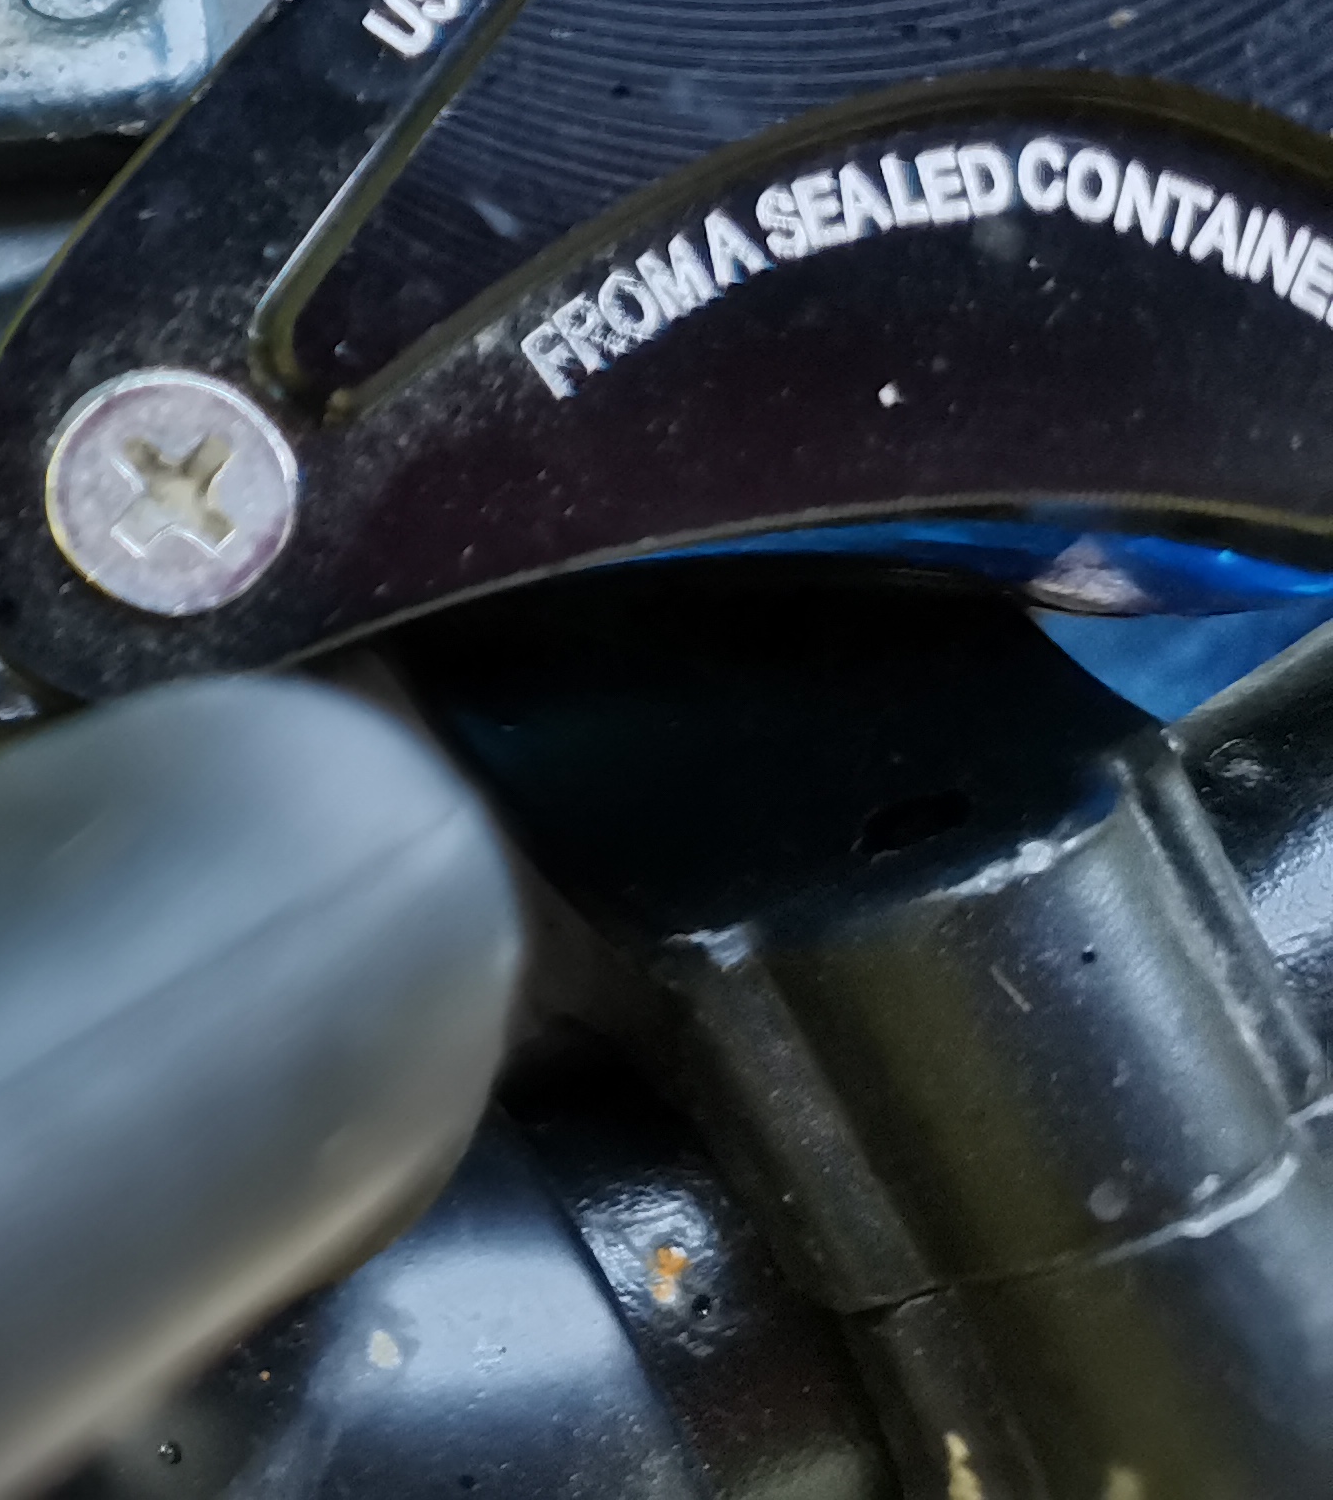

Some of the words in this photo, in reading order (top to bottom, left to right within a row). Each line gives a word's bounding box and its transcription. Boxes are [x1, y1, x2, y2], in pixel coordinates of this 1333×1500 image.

[519, 233, 724, 400] FROM
[755, 141, 1016, 260] SEALED
[1018, 136, 1333, 330] CONTAINE
